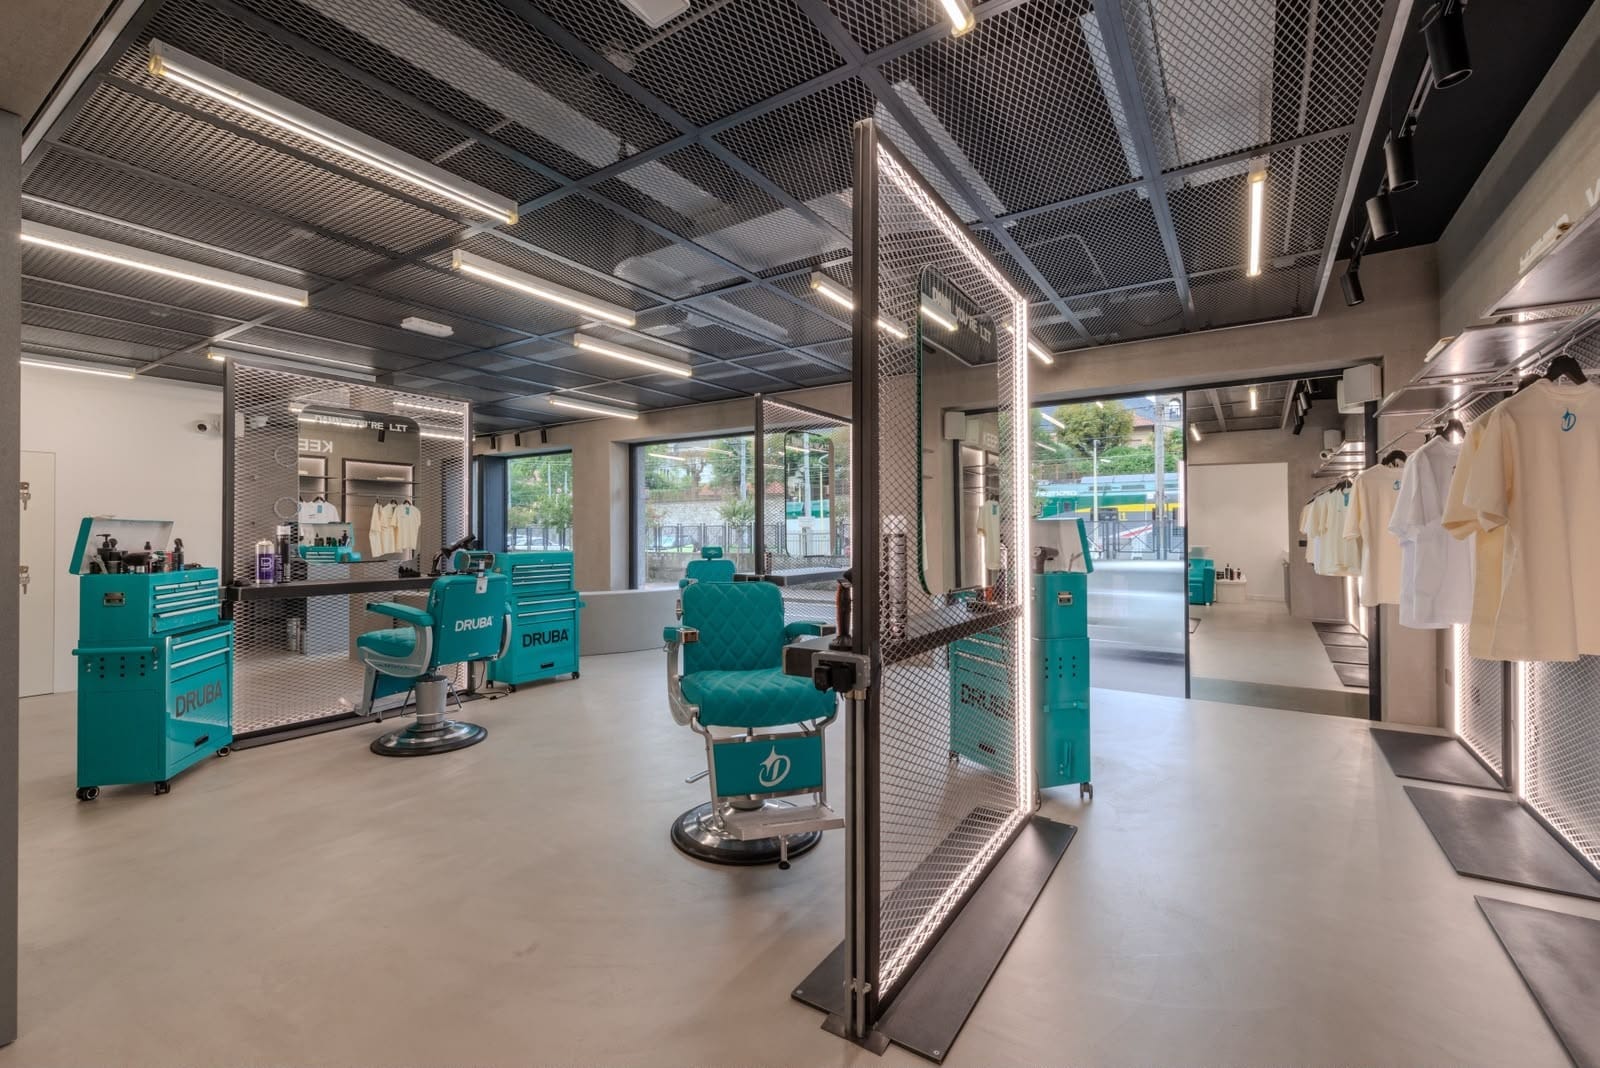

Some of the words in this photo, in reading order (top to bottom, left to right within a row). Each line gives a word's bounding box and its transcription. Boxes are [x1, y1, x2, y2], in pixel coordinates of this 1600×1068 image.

[389, 423, 408, 432] LIT
[454, 616, 493, 632] DRUBA
[522, 629, 569, 648] DRUBA
[175, 680, 223, 718] DRUBA
